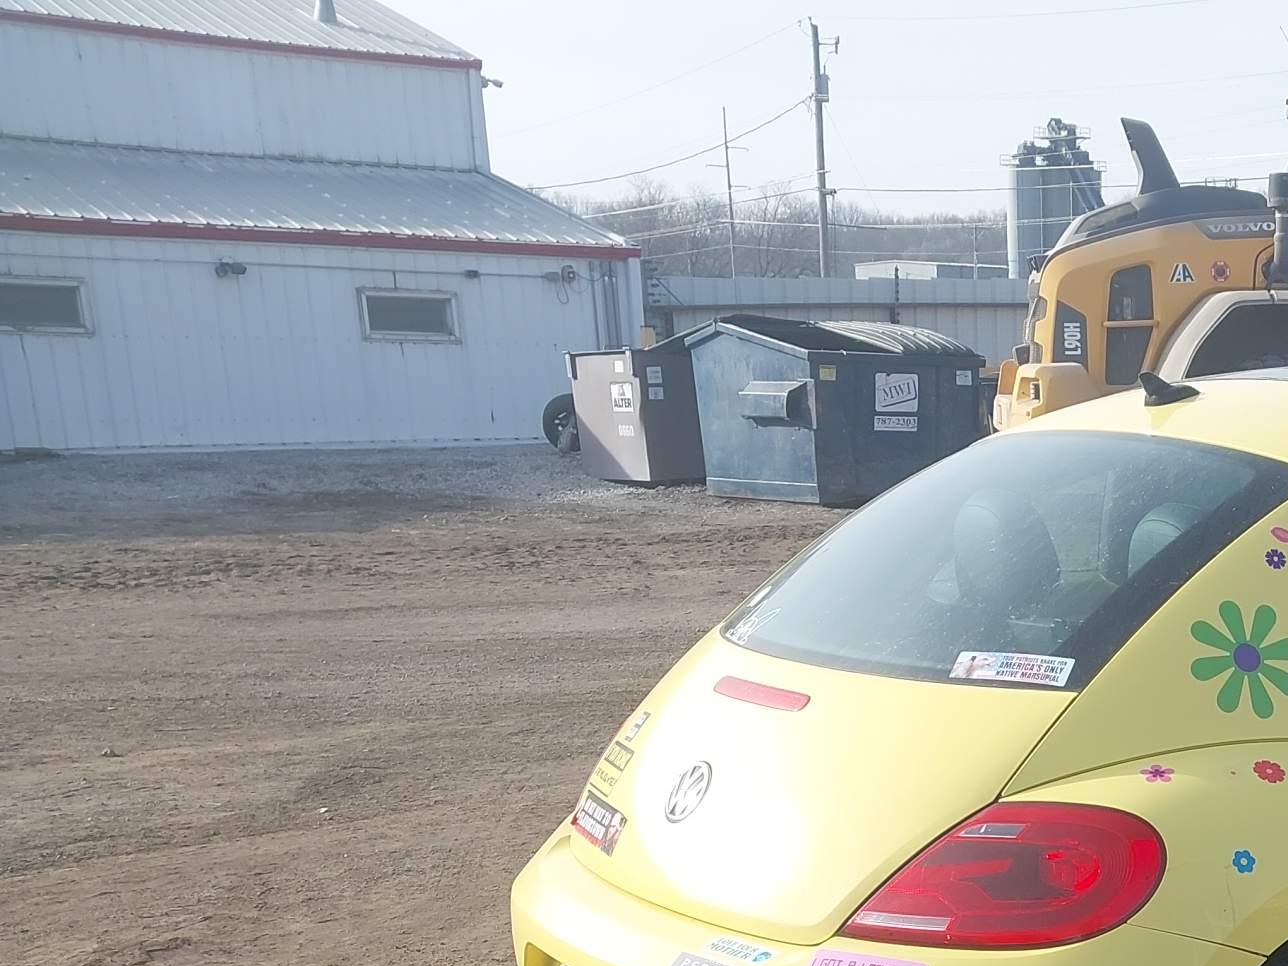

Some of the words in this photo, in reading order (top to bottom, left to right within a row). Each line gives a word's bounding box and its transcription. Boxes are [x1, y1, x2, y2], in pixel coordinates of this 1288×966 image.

[1207, 221, 1276, 233] VOLVO
[1063, 322, 1082, 355] L90H
[881, 382, 912, 401] MWI
[613, 398, 632, 409] ALTER
[999, 662, 1044, 673] AMERICA'S
[1044, 665, 1065, 675] ONLY
[995, 670, 1019, 679] NATIVE
[1019, 672, 1060, 683] MARSUPIAL
[710, 943, 752, 960] MOTHER
